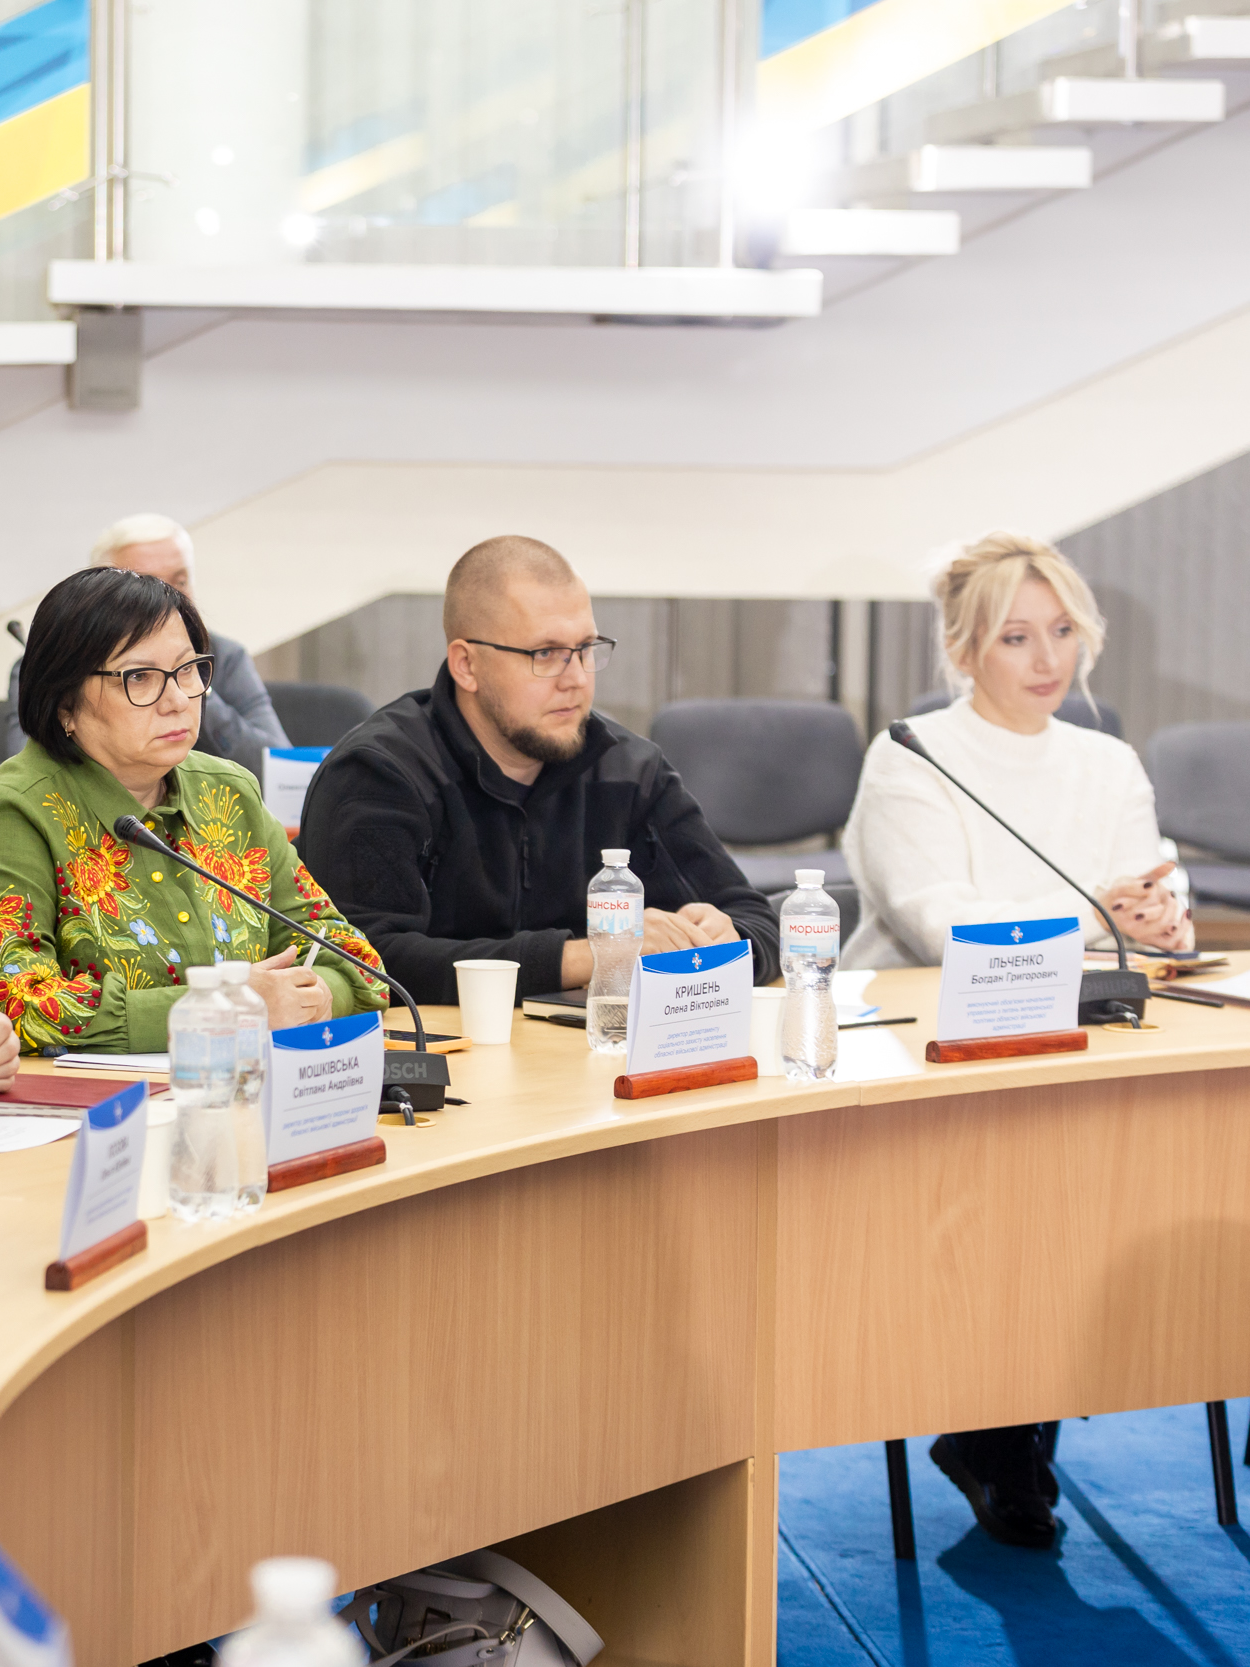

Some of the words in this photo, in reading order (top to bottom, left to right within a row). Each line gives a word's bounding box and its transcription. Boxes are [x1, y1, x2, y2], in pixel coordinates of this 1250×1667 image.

[989, 953, 1044, 969] ІЛЬЧЕНКО
[971, 974, 1004, 985] Богдан
[1006, 970, 1058, 984] Григорович
[675, 980, 721, 999] КРИШЕНЬ
[664, 1004, 688, 1015] Олена
[690, 997, 730, 1011] Вікторівна
[299, 1056, 360, 1081] МОШКІВСЬКА
[384, 1062, 427, 1079] SCH
[293, 1083, 327, 1099] Світлана
[328, 1075, 364, 1091] Андріївна
